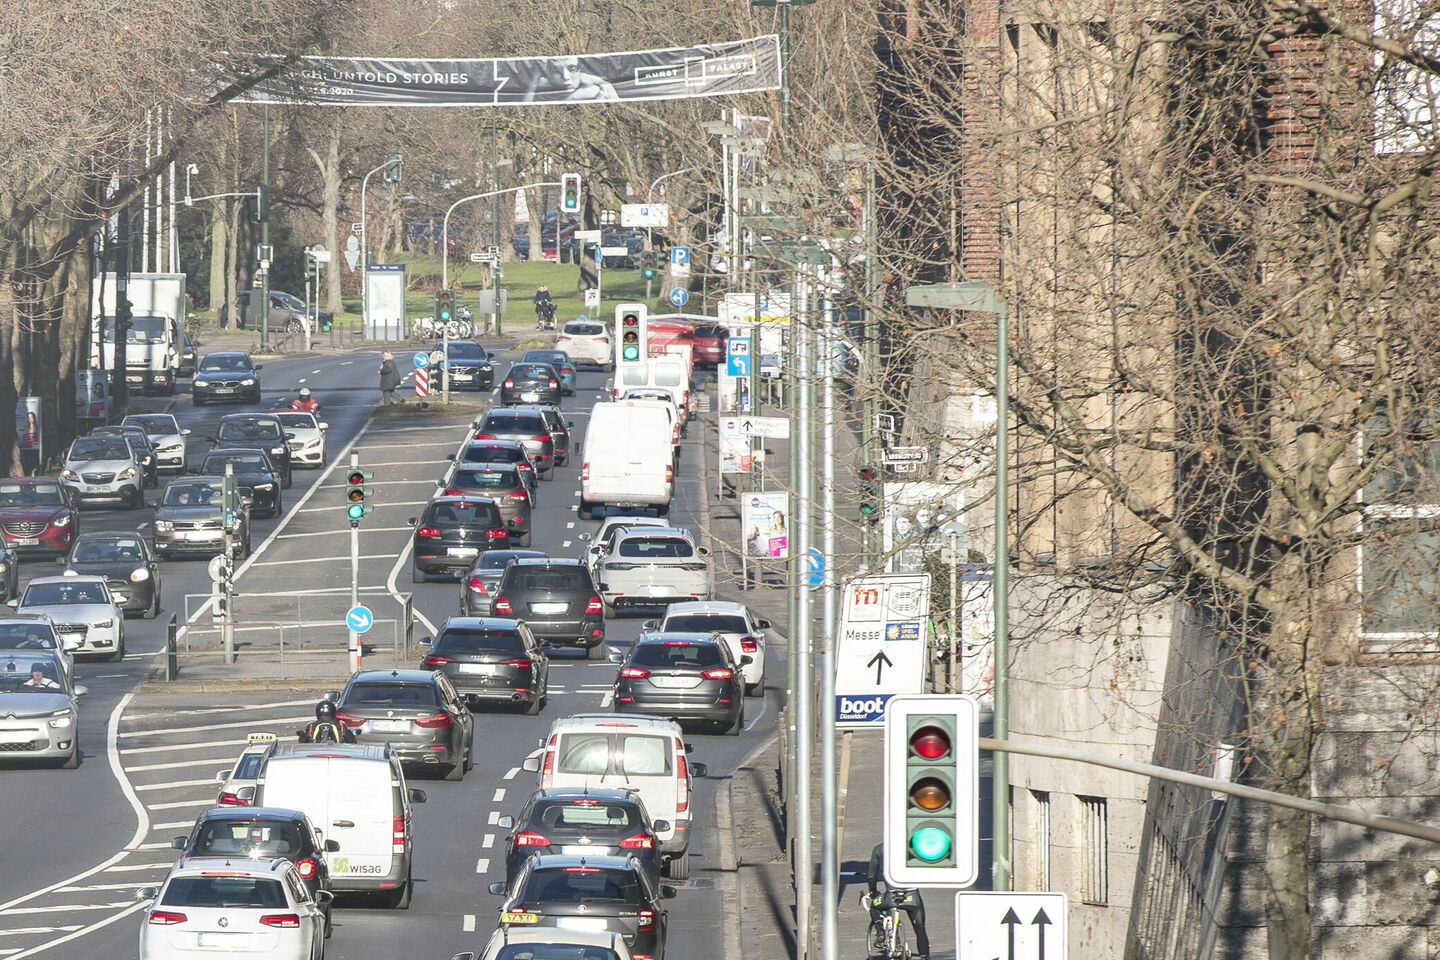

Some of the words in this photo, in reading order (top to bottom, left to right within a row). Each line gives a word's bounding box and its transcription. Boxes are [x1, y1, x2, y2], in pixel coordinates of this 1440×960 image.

[710, 61, 748, 72] PALAST
[333, 71, 397, 84] UNTOLD
[402, 72, 469, 84] STORIES
[645, 69, 678, 79] KUNST
[675, 249, 686, 264] P
[845, 630, 880, 641] Messe
[840, 697, 884, 714] boot
[507, 913, 534, 923] TAXI
